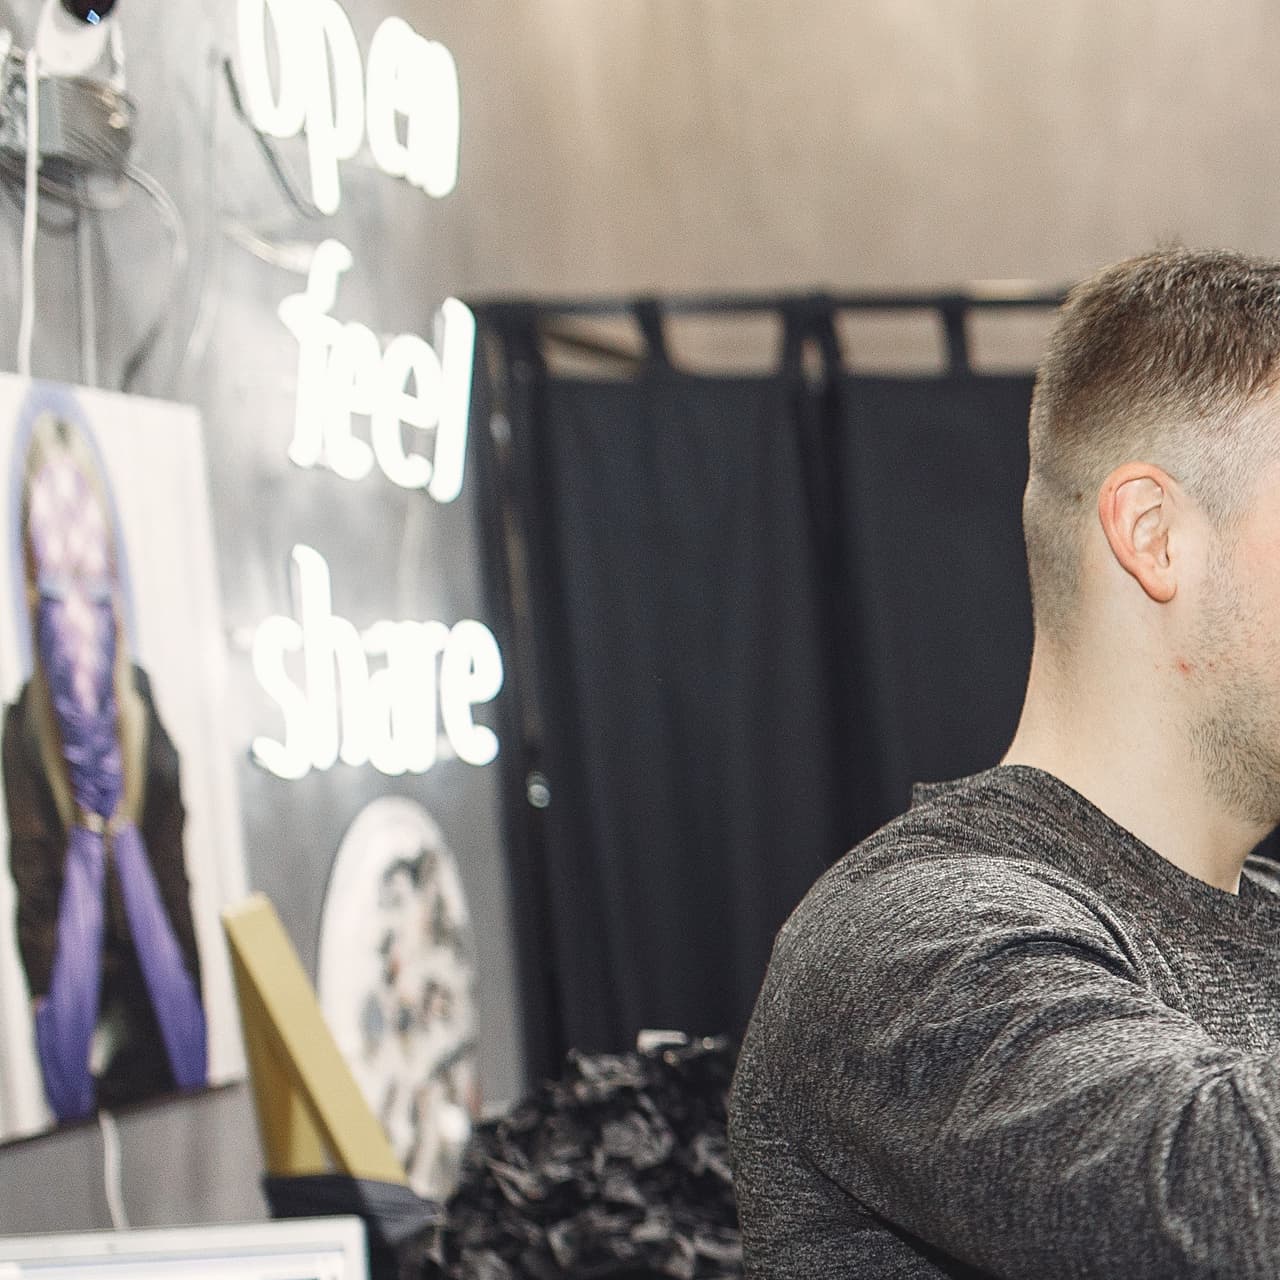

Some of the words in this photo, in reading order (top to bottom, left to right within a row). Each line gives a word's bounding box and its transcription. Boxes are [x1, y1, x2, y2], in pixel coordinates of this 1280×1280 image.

[237, 0, 460, 215] open
[278, 239, 474, 502] feel
[252, 545, 503, 779] share
